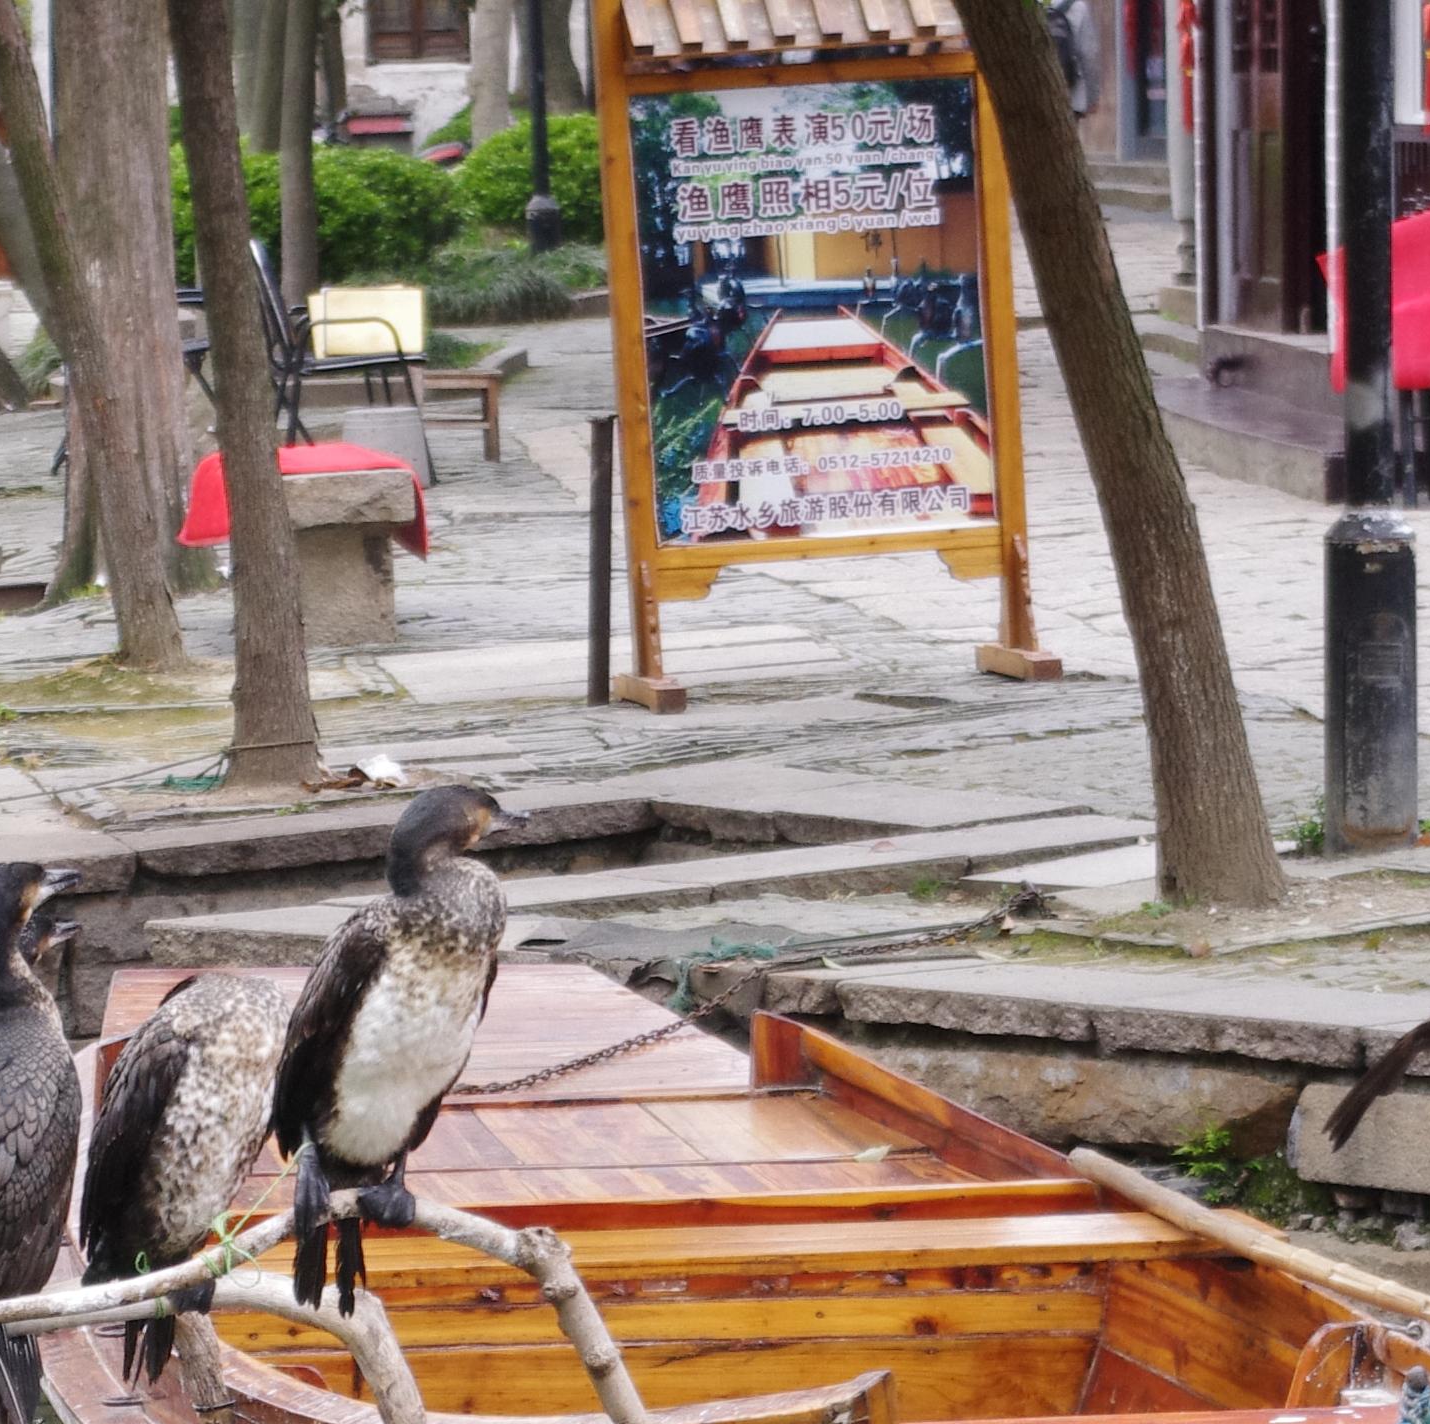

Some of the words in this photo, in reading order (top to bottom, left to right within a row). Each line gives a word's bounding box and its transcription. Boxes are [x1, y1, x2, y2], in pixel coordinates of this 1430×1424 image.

[673, 162, 700, 174] Kan
[704, 160, 721, 175] yu
[725, 157, 757, 173] ying
[761, 155, 792, 168] biao
[826, 153, 842, 164] 50
[847, 151, 881, 165] yuan
[680, 171, 934, 219] 渔鹰照相5元/位
[702, 225, 739, 239] ying
[743, 220, 785, 234] zhao
[789, 217, 836, 231] xiang
[840, 214, 851, 227] 5
[854, 213, 896, 229] yuan
[684, 487, 967, 529] 江苏水乡旅游股份有限公司
